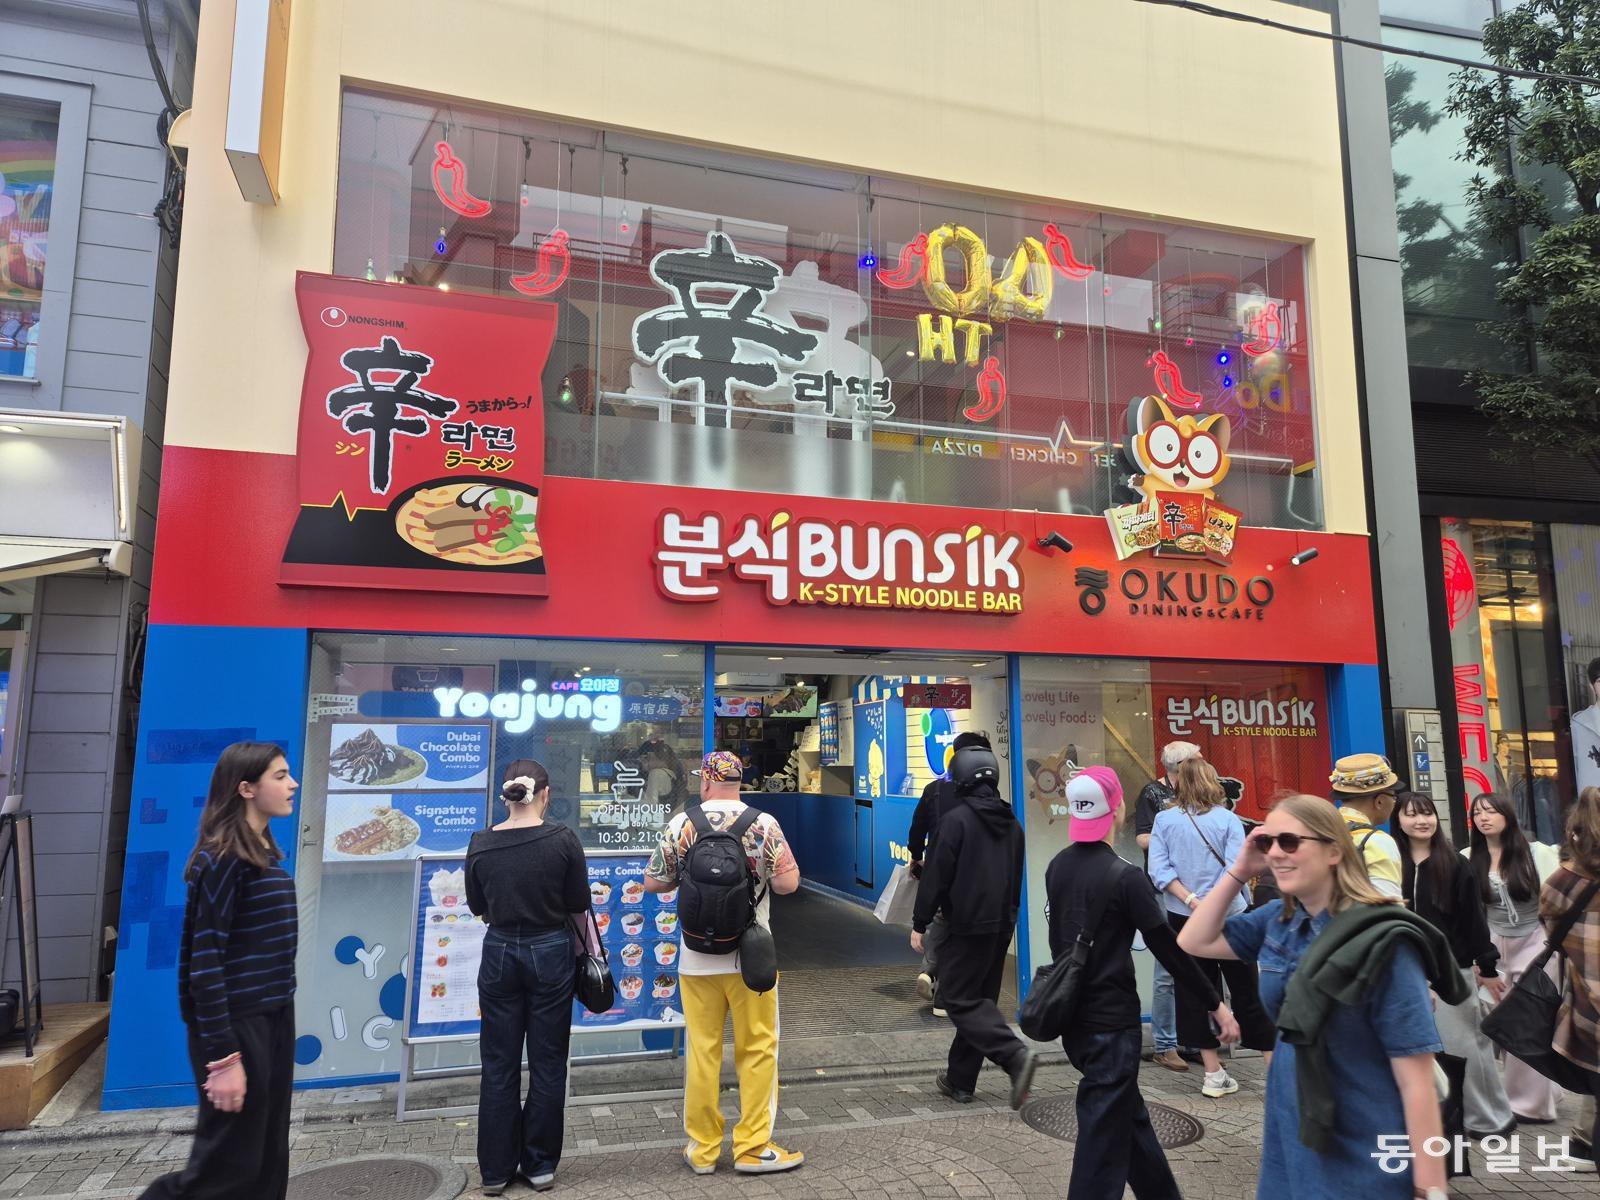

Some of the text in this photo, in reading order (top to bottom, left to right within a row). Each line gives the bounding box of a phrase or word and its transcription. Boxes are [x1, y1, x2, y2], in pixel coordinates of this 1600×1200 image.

[632, 230, 818, 430] 辛
[792, 369, 896, 417] 라면
[326, 335, 459, 495] 辛
[441, 420, 517, 453] 라면
[335, 441, 366, 457] シン
[445, 449, 514, 472] ラーメン
[1163, 502, 1187, 536] 辛
[657, 512, 790, 601] 분식
[1120, 568, 1275, 607] OKUDO
[799, 582, 1023, 612] K-STYLE NOODLE BAR
[551, 677, 620, 693] CAFE 요아정
[1021, 690, 1081, 706] ovely Life
[433, 679, 623, 734] Yoajung
[628, 702, 670, 716] 原宿店
[1021, 710, 1056, 728] ovely
[1060, 710, 1087, 724] Food
[1166, 695, 1220, 736] 분식
[446, 731, 482, 742] Dubai
[1223, 726, 1318, 738] K-STYLE NOODLE BAR
[419, 741, 481, 752] Chocolate
[439, 752, 481, 763] Combo
[414, 805, 477, 818] Signature
[598, 803, 671, 815] OPEN HOURS
[434, 815, 477, 826] Combo
[598, 832, 630, 844] 10:30
[638, 831, 663, 843] 21:0
[587, 866, 611, 876] Best
